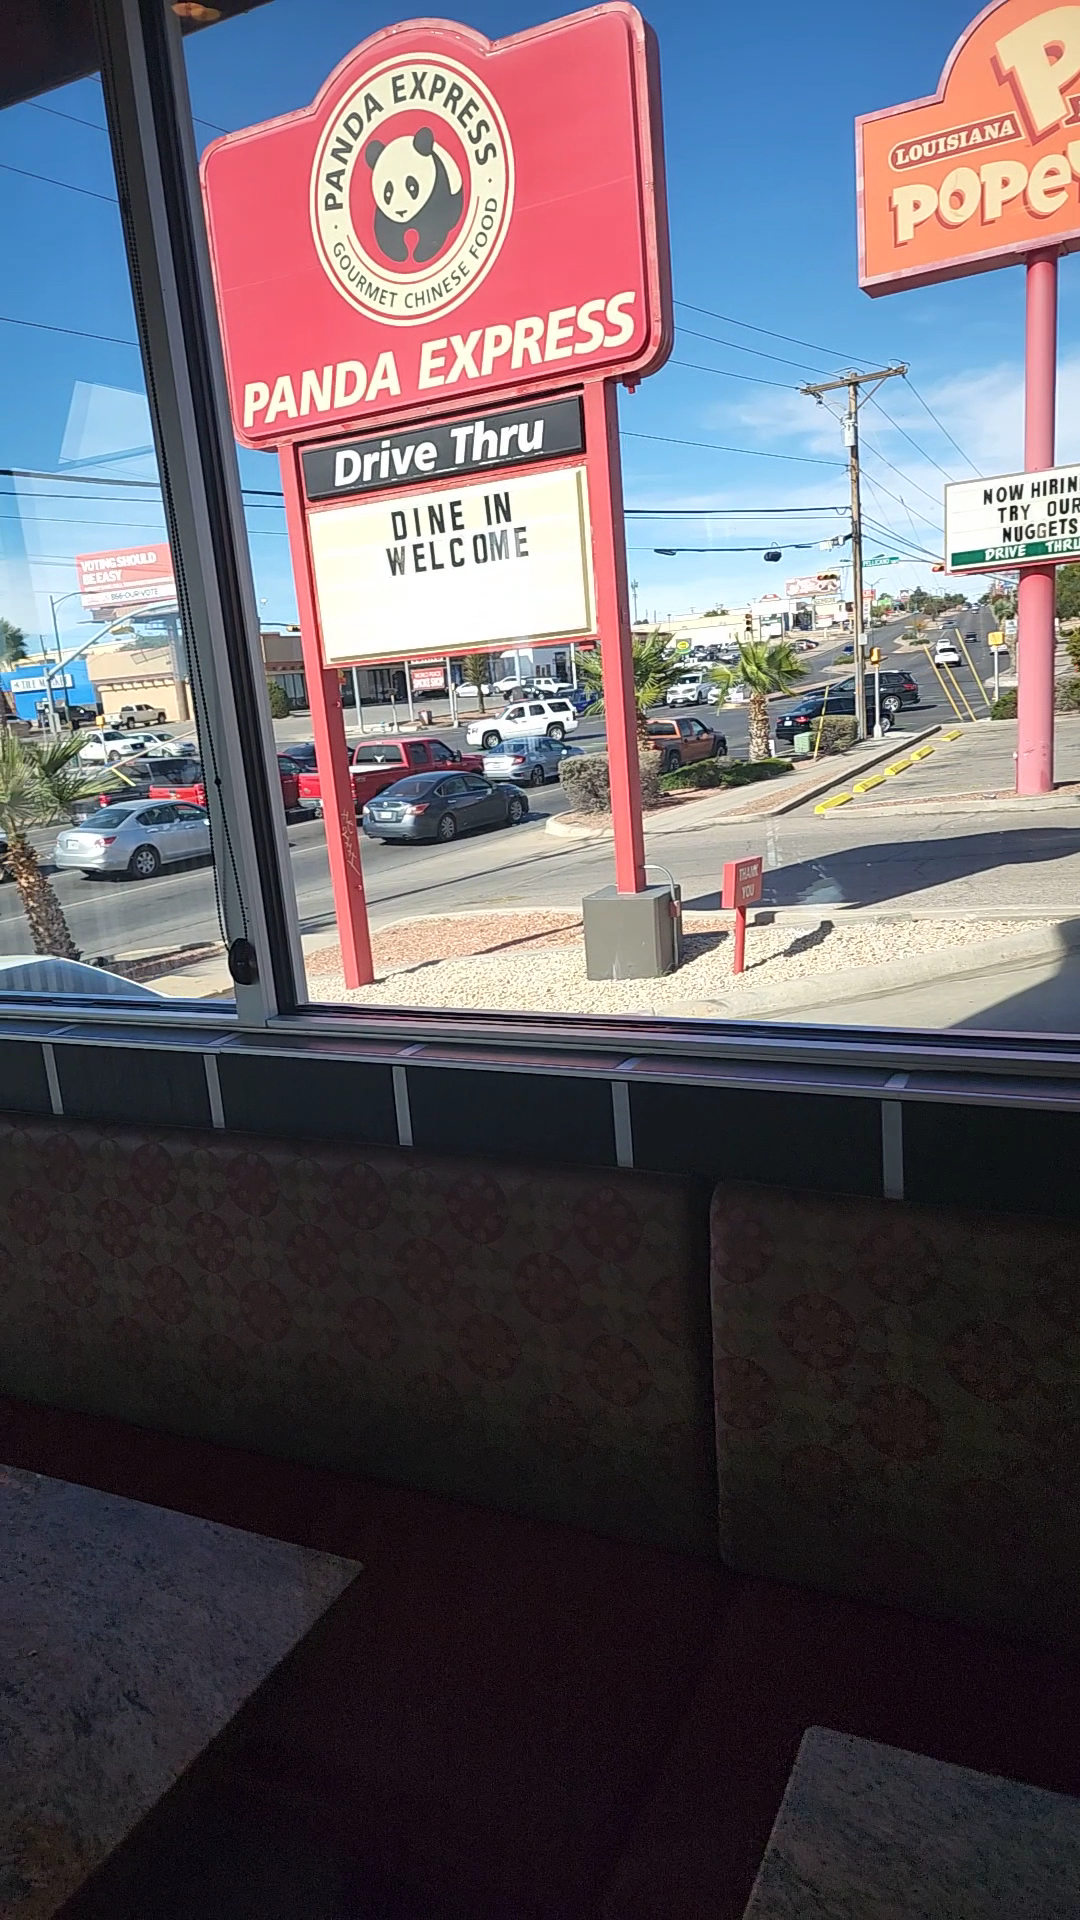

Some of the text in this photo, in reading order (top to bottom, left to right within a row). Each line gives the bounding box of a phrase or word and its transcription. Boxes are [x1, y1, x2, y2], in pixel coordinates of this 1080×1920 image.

[324, 71, 497, 211] PANDA EXPRESS
[895, 119, 1016, 166] LOUISIANA
[333, 197, 498, 309] GOURMET CHINESE FOOD
[243, 291, 636, 428] PANDA EXPRESS
[334, 419, 544, 487] Drive Thru
[983, 476, 1080, 505] NOW HIRIN
[391, 491, 512, 541] DINE IN
[997, 497, 1080, 523] TRY OUR
[1002, 518, 1078, 543] NUGGETS
[81, 552, 157, 572] VOTING SHOULD
[386, 526, 529, 577] WELCOME
[985, 538, 1080, 561] DRIVE THRU
[82, 573, 96, 585] BE
[96, 569, 122, 584] EASY
[739, 863, 759, 881] THANK
[741, 883, 755, 899] YOU
